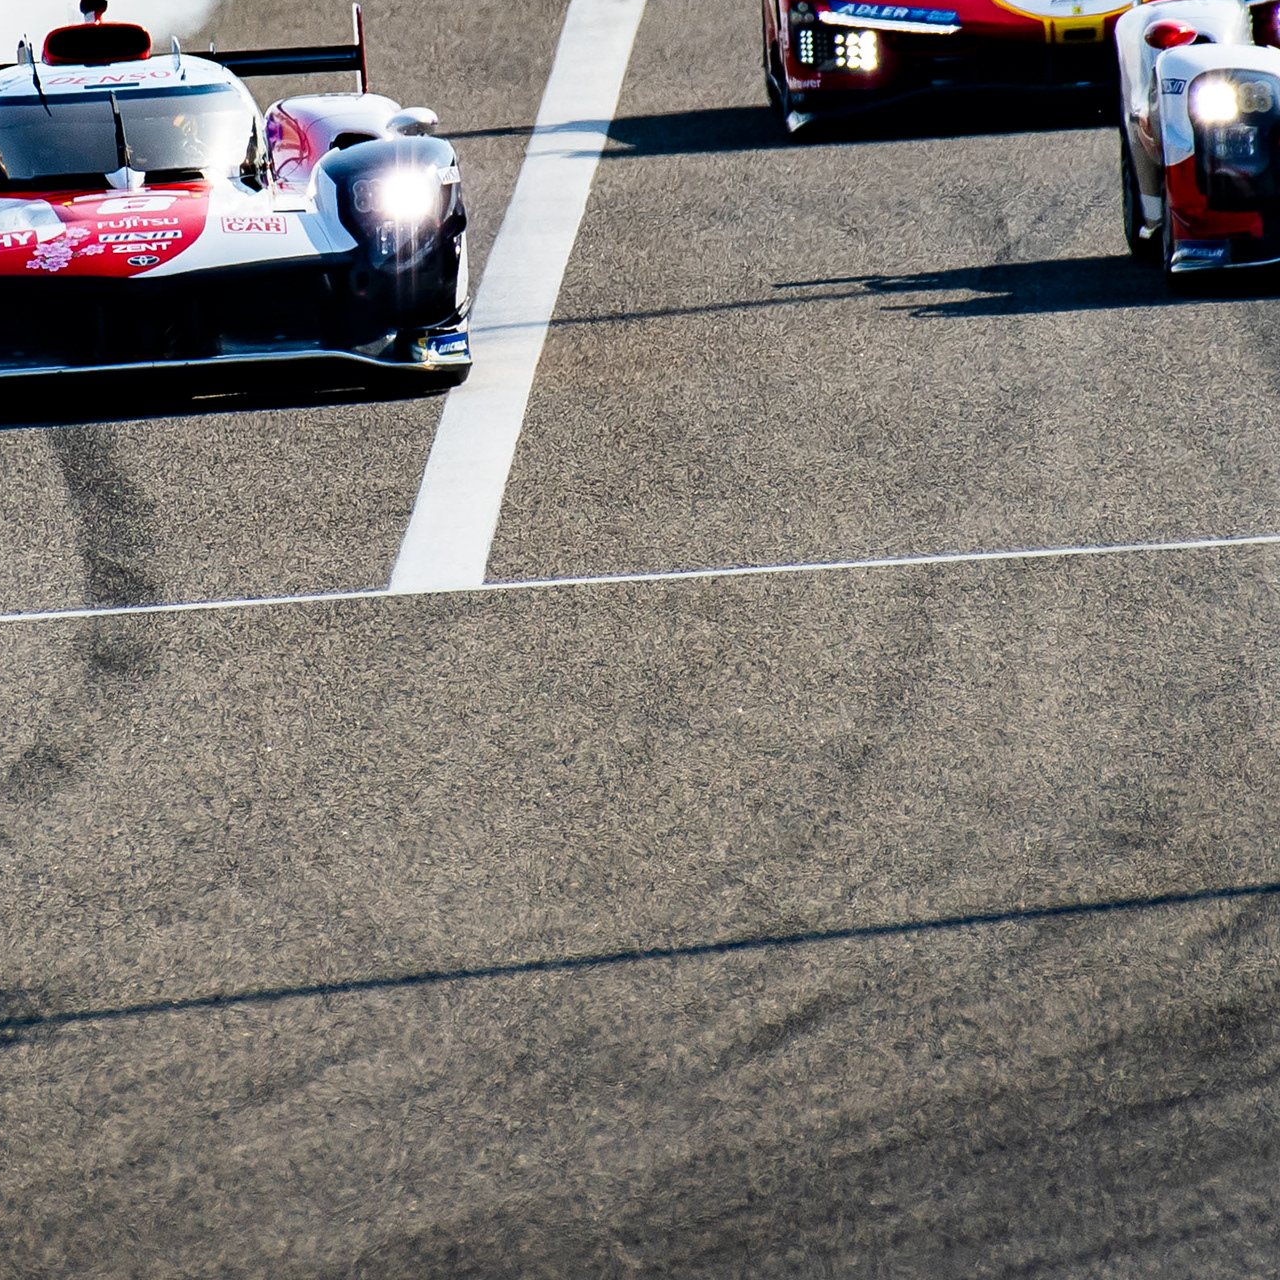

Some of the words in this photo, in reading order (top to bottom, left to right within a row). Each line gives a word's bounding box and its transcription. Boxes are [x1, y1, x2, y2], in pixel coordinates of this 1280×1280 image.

[837, 3, 910, 19] ADLER
[46, 71, 172, 86] DENSO
[96, 216, 179, 230] FUJITSU
[227, 222, 282, 232] CAR
[111, 240, 173, 254] ZENT
